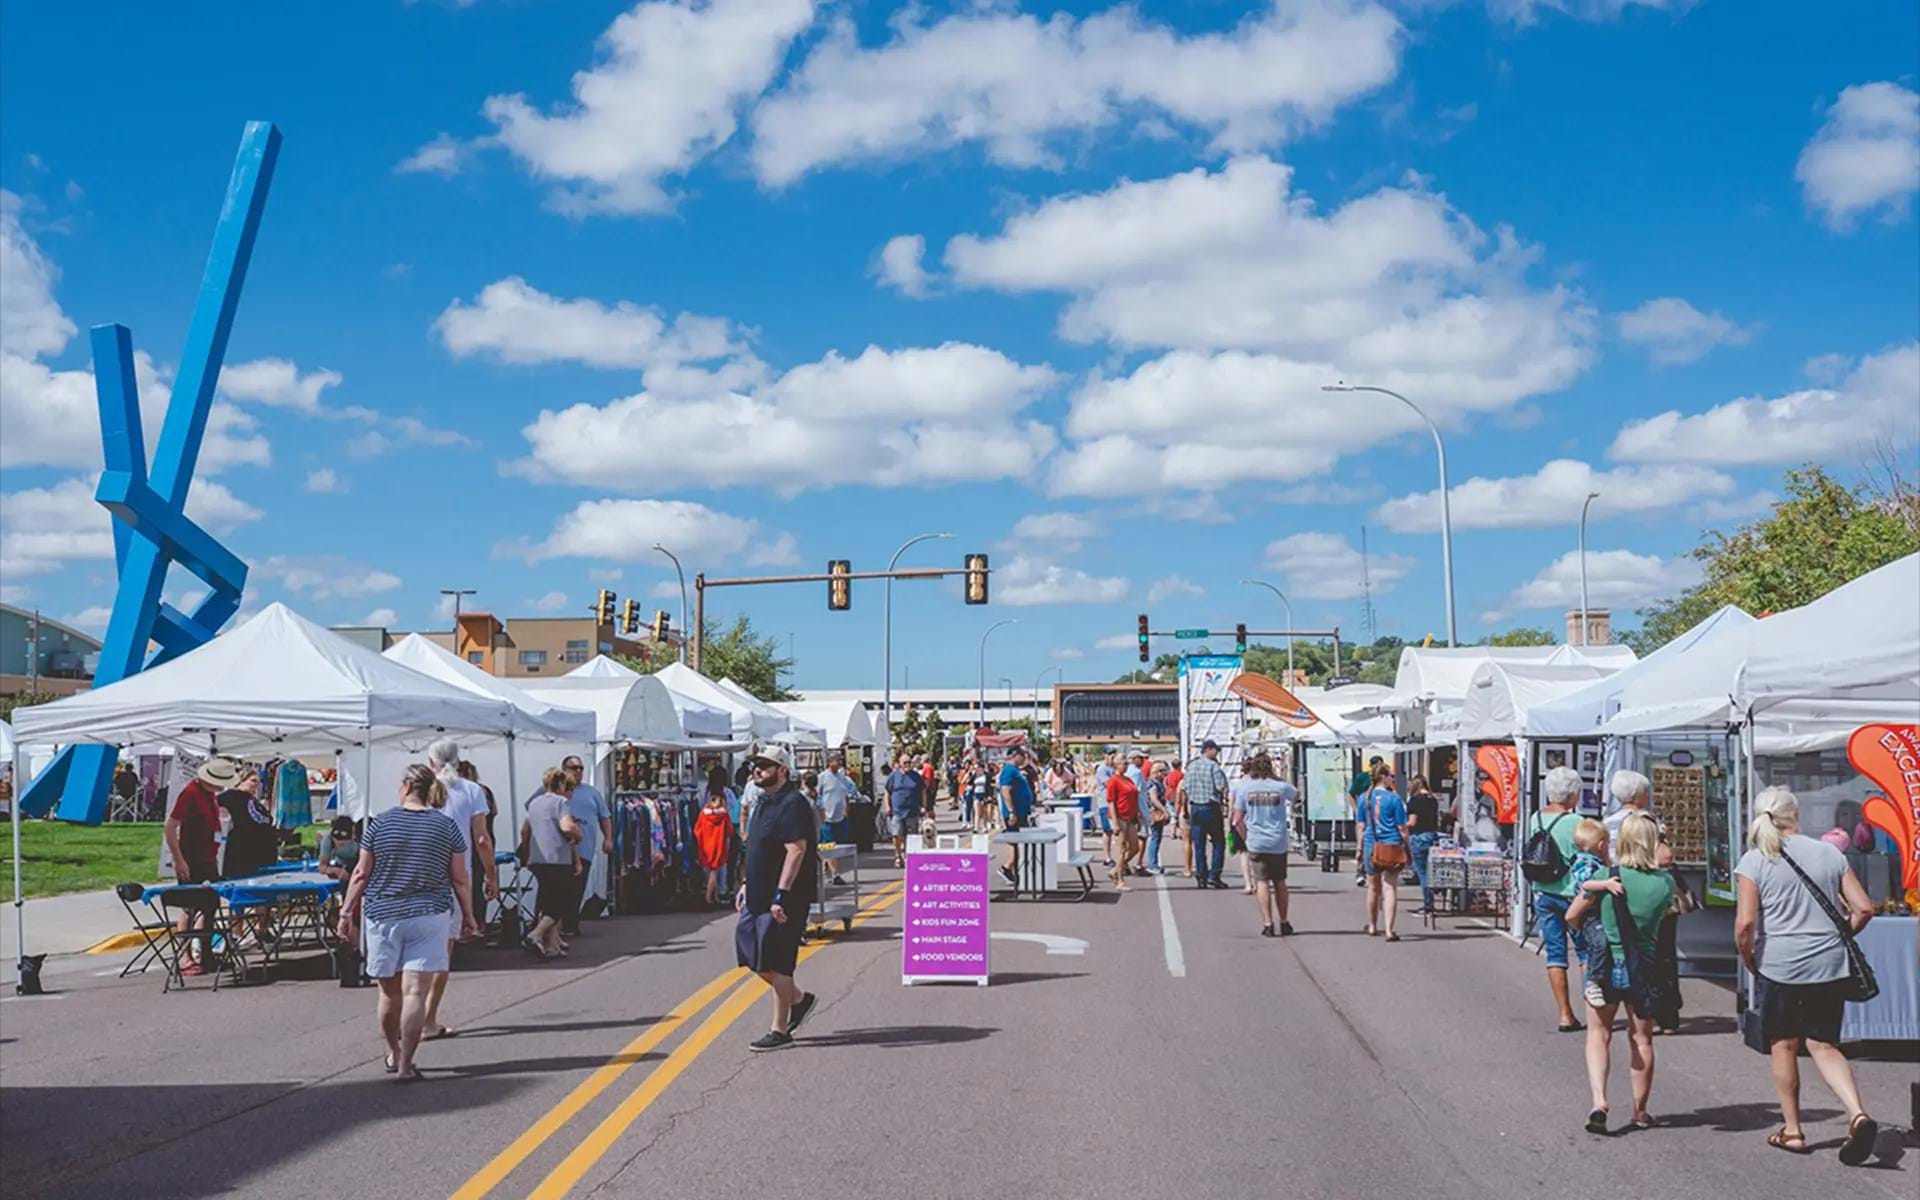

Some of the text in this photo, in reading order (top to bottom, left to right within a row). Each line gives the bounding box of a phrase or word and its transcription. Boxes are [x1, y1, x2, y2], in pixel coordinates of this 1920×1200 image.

[1880, 731, 1920, 861] EXCELLECE
[922, 884, 983, 892] ARTIST BOOTHS
[922, 901, 980, 909] ART ACTIVITIES
[922, 918, 980, 926] KIDS FUN ZONE
[921, 936, 967, 944] MAIN STAGE
[921, 953, 983, 961] FOOD VENDORS
